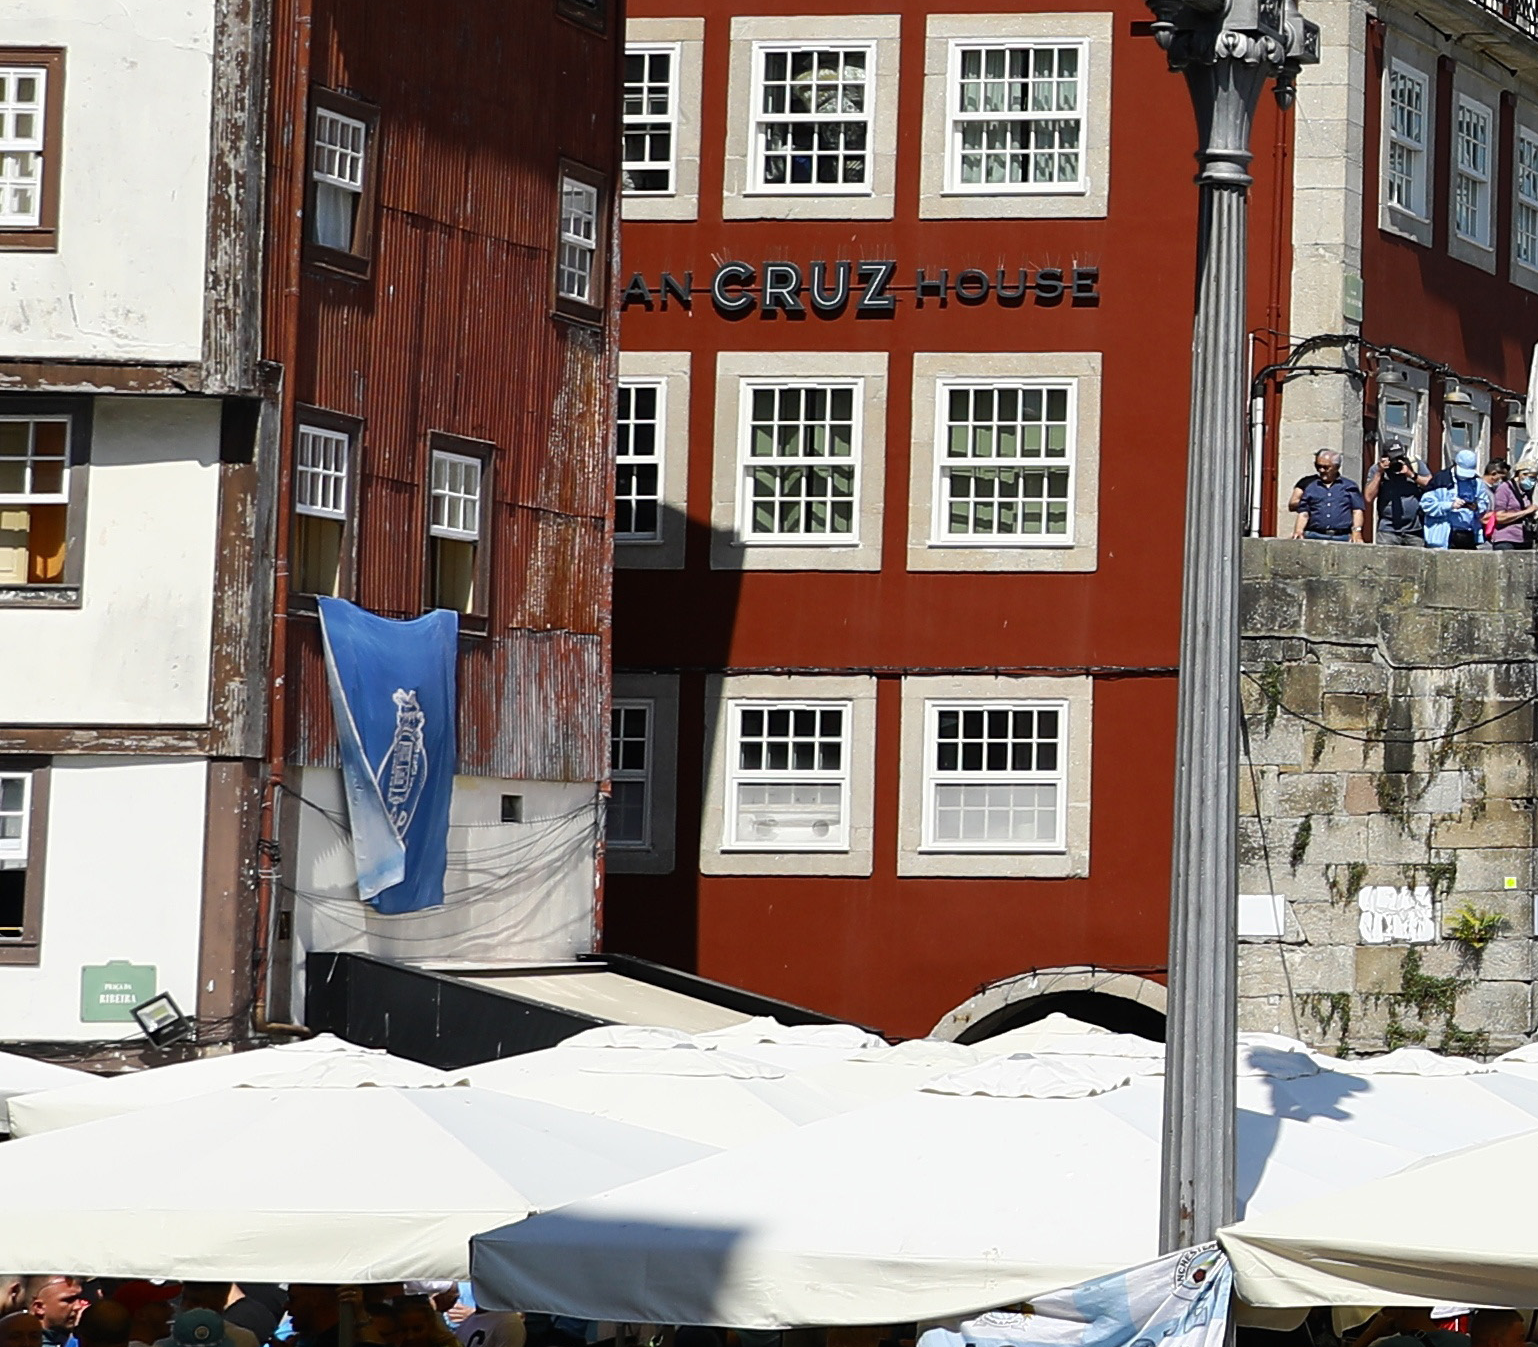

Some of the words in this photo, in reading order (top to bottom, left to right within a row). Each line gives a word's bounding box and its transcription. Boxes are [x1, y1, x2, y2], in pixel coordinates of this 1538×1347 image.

[711, 260, 896, 312] CRUZ
[916, 265, 1098, 303] HOUSE
[99, 994, 137, 1004] RIBEIRA
